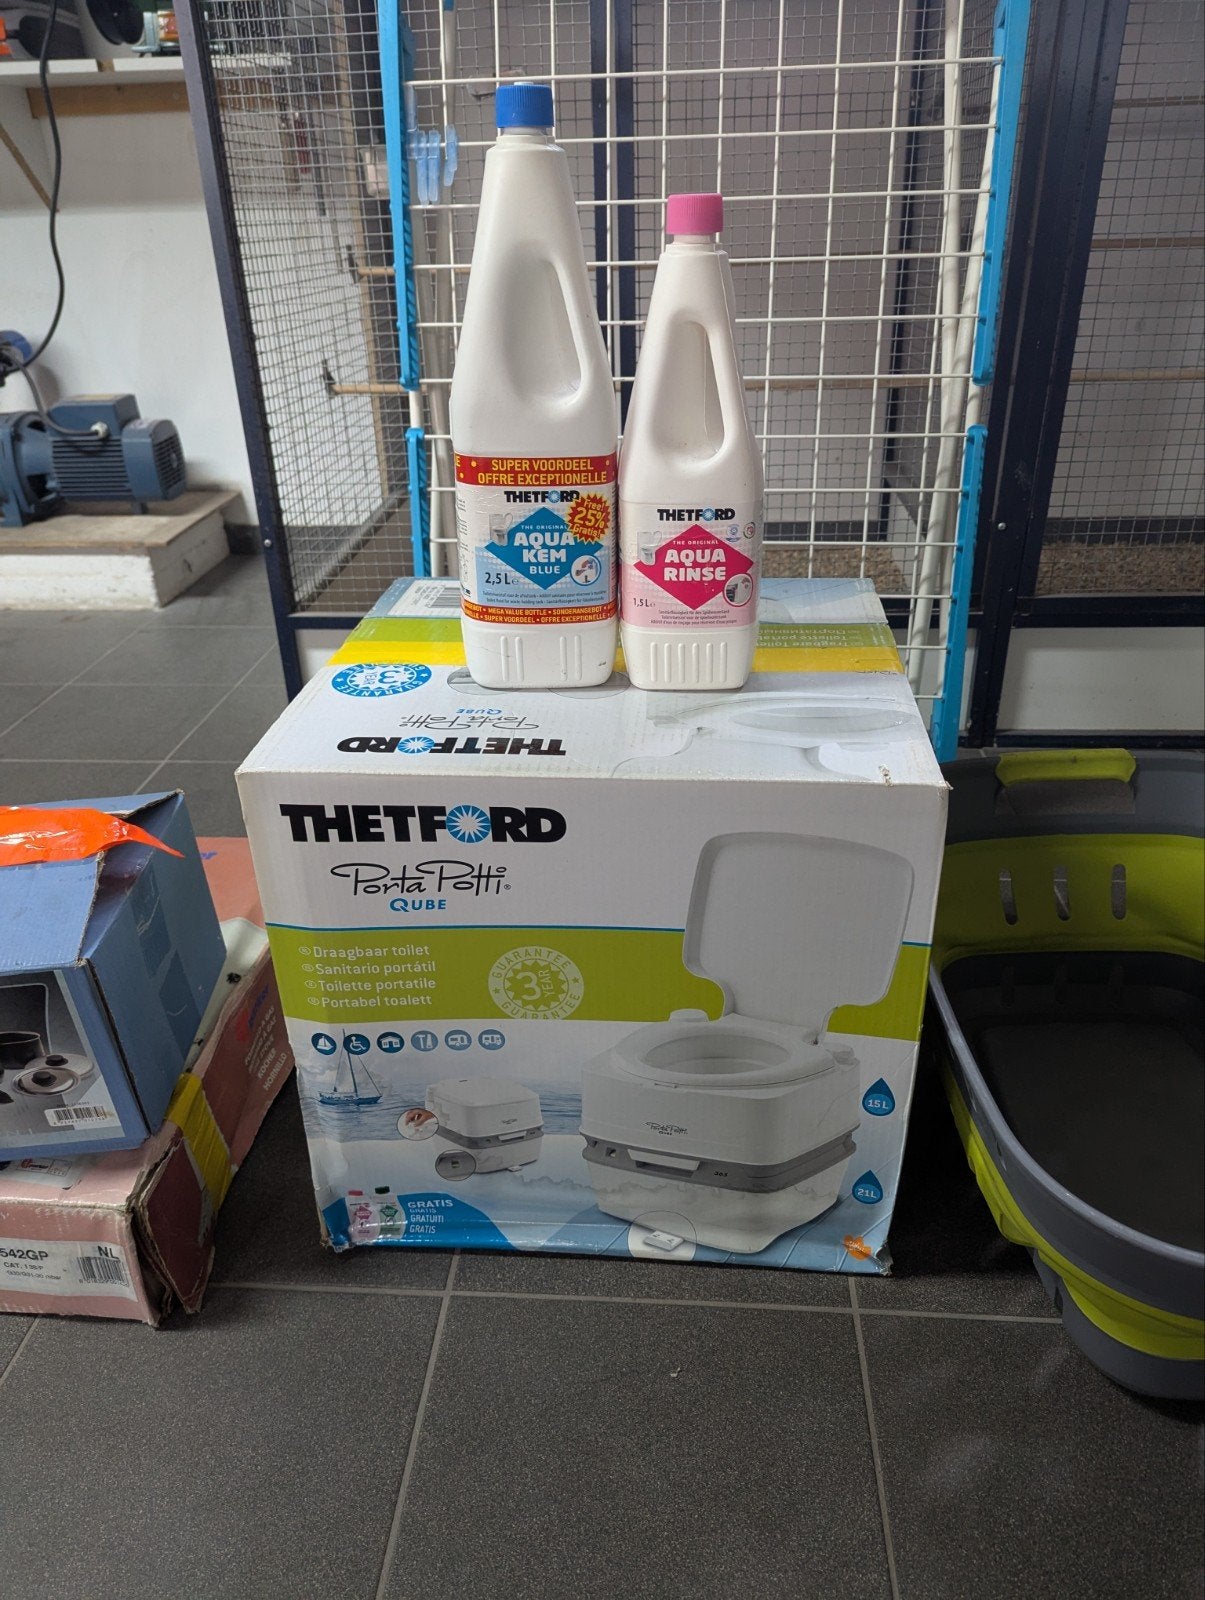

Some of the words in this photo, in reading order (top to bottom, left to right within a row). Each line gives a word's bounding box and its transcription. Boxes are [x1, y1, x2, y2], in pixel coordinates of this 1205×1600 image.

[491, 459, 532, 471] SUPER
[532, 459, 594, 471] VOORDEEL
[478, 472, 515, 485] OFFRE
[517, 471, 607, 485] EXCEPTIONELLE
[584, 499, 605, 511] Free!
[574, 506, 605, 528] 25%
[657, 508, 736, 522] THETFORD
[573, 523, 601, 538] Gratis!
[514, 532, 575, 550] AQUA
[522, 548, 567, 563] KEM
[664, 548, 726, 566] AQUA
[529, 565, 561, 575] BLUE
[663, 566, 726, 581] RINSE
[485, 572, 502, 585] 2,5
[504, 573, 511, 585] L
[633, 597, 644, 607] 1,5
[553, 606, 602, 615] SONDERANGEBOT
[562, 613, 607, 623] EXCEPTIONELLE
[792, 640, 848, 648] Tragbare
[378, 670, 401, 684] 3
[337, 736, 567, 756] THETFORD
[279, 803, 567, 844] THETFORD
[330, 862, 427, 896] Porta
[389, 897, 447, 912] QUBE
[313, 946, 388, 961] Draagbaar
[391, 944, 430, 956] toilet
[315, 962, 380, 975] Sanitario
[383, 960, 436, 976] portátil
[491, 947, 572, 979] GUARANTEE
[319, 980, 372, 992] Toilette
[376, 977, 436, 994] portatile
[516, 971, 542, 1001] 3
[538, 969, 556, 998] YEAR
[322, 995, 381, 1008] Portabel
[384, 994, 433, 1007] toalett
[263, 1052, 288, 1091] HORNILLO
[407, 1199, 454, 1208] GRATIS
[409, 1224, 437, 1234] GRATIS
[0, 1247, 49, 1261] 542GP
[97, 1245, 120, 1260] NL
